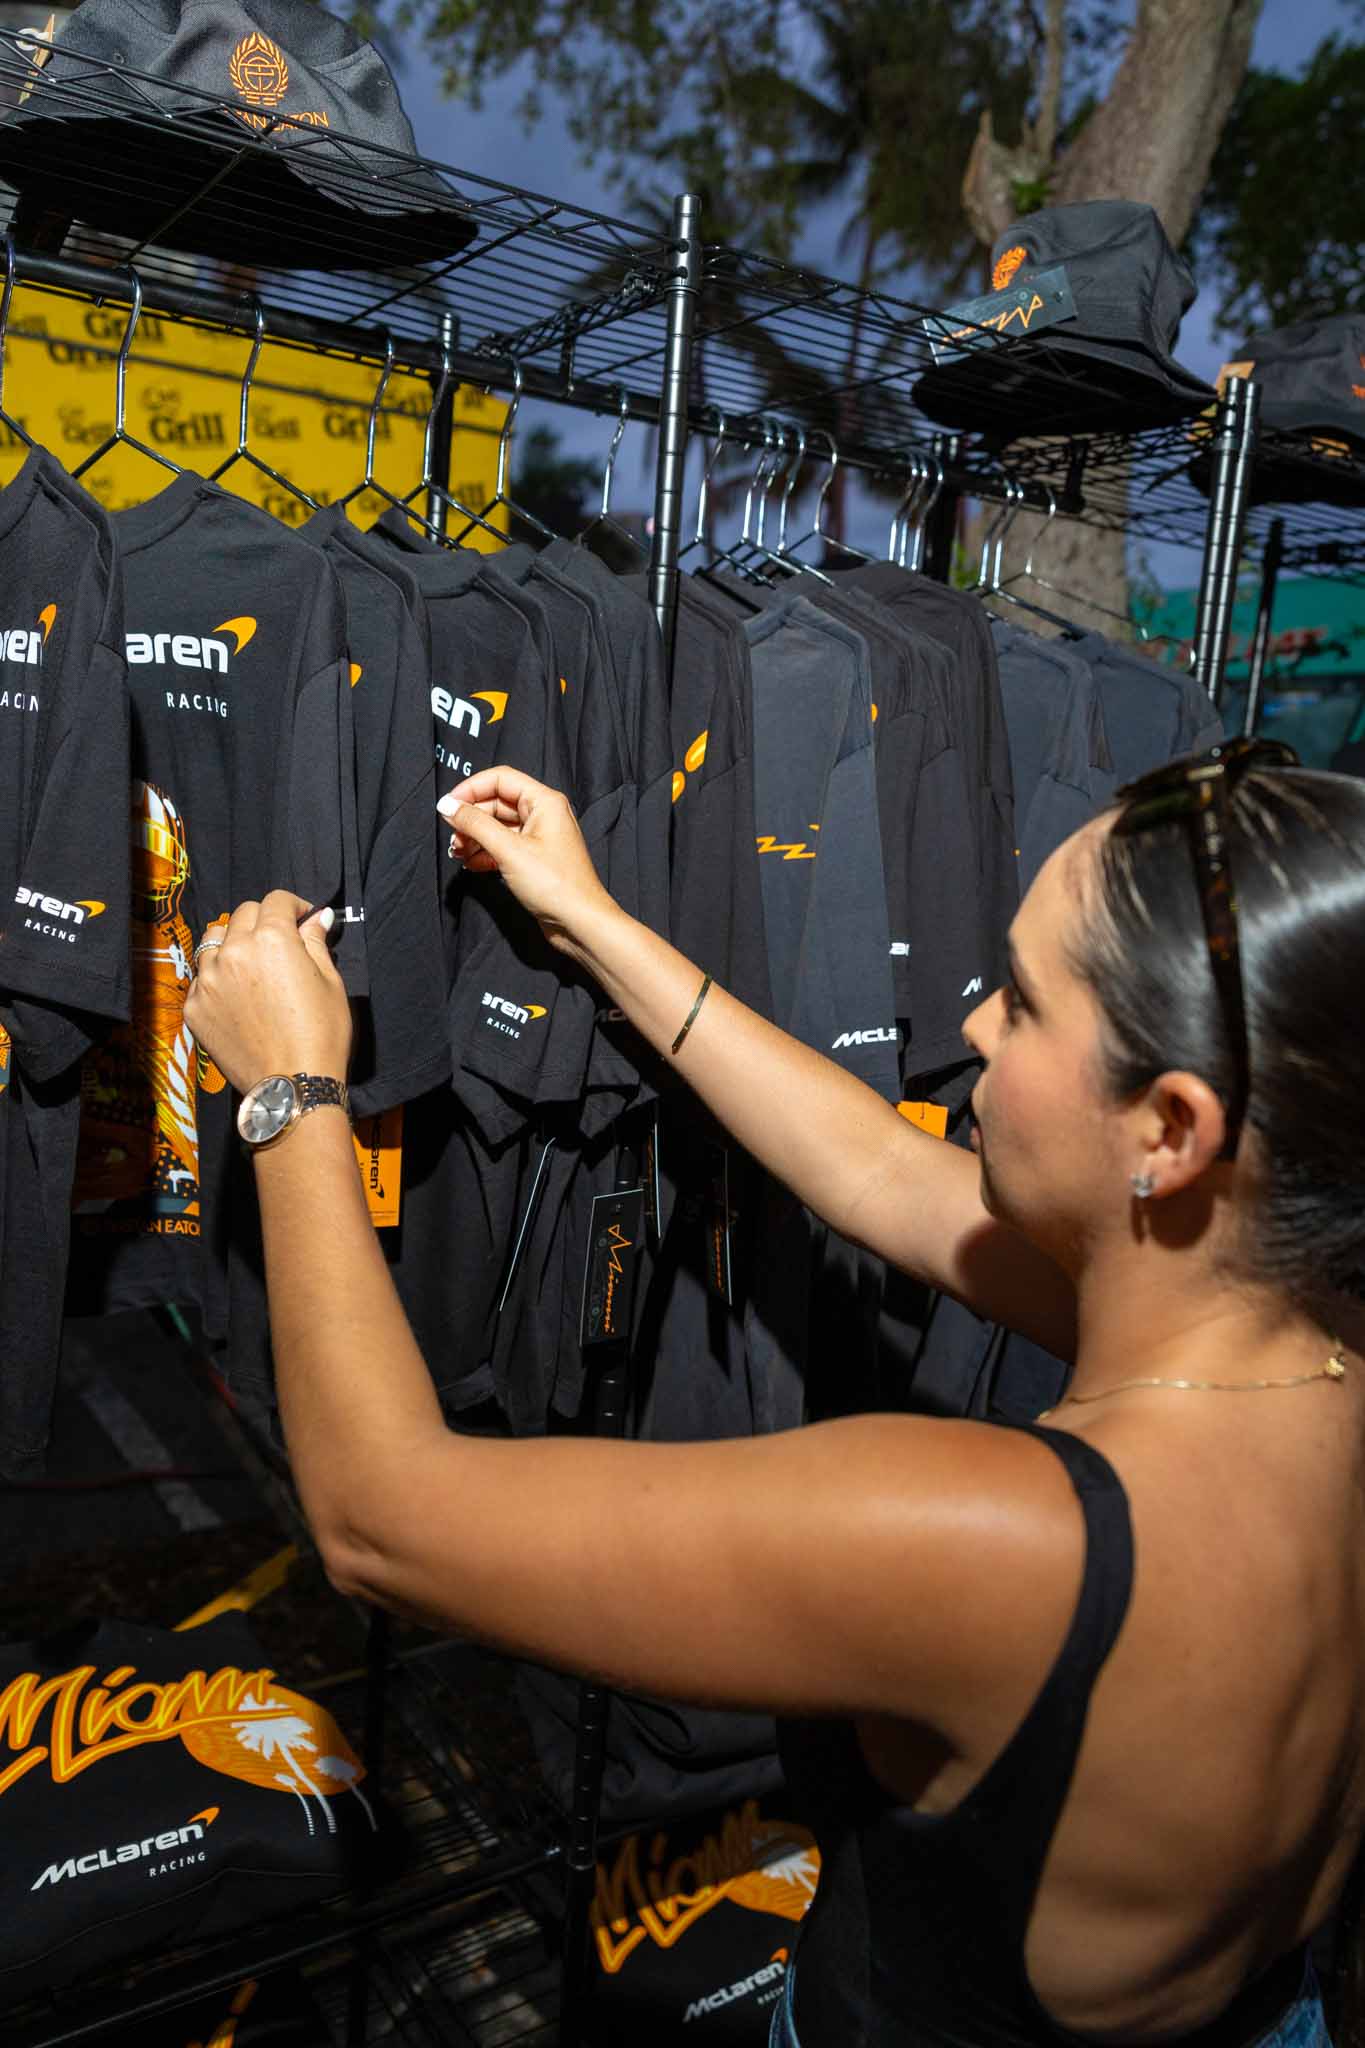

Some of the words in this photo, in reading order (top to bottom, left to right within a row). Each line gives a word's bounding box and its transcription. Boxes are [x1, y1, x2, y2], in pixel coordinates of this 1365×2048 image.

[25, 918, 77, 943] RACING
[486, 1017, 521, 1039] RACING
[30, 1822, 204, 1892] McLaren
[148, 1851, 207, 1878] RACING
[681, 1960, 785, 2024] McLaren
